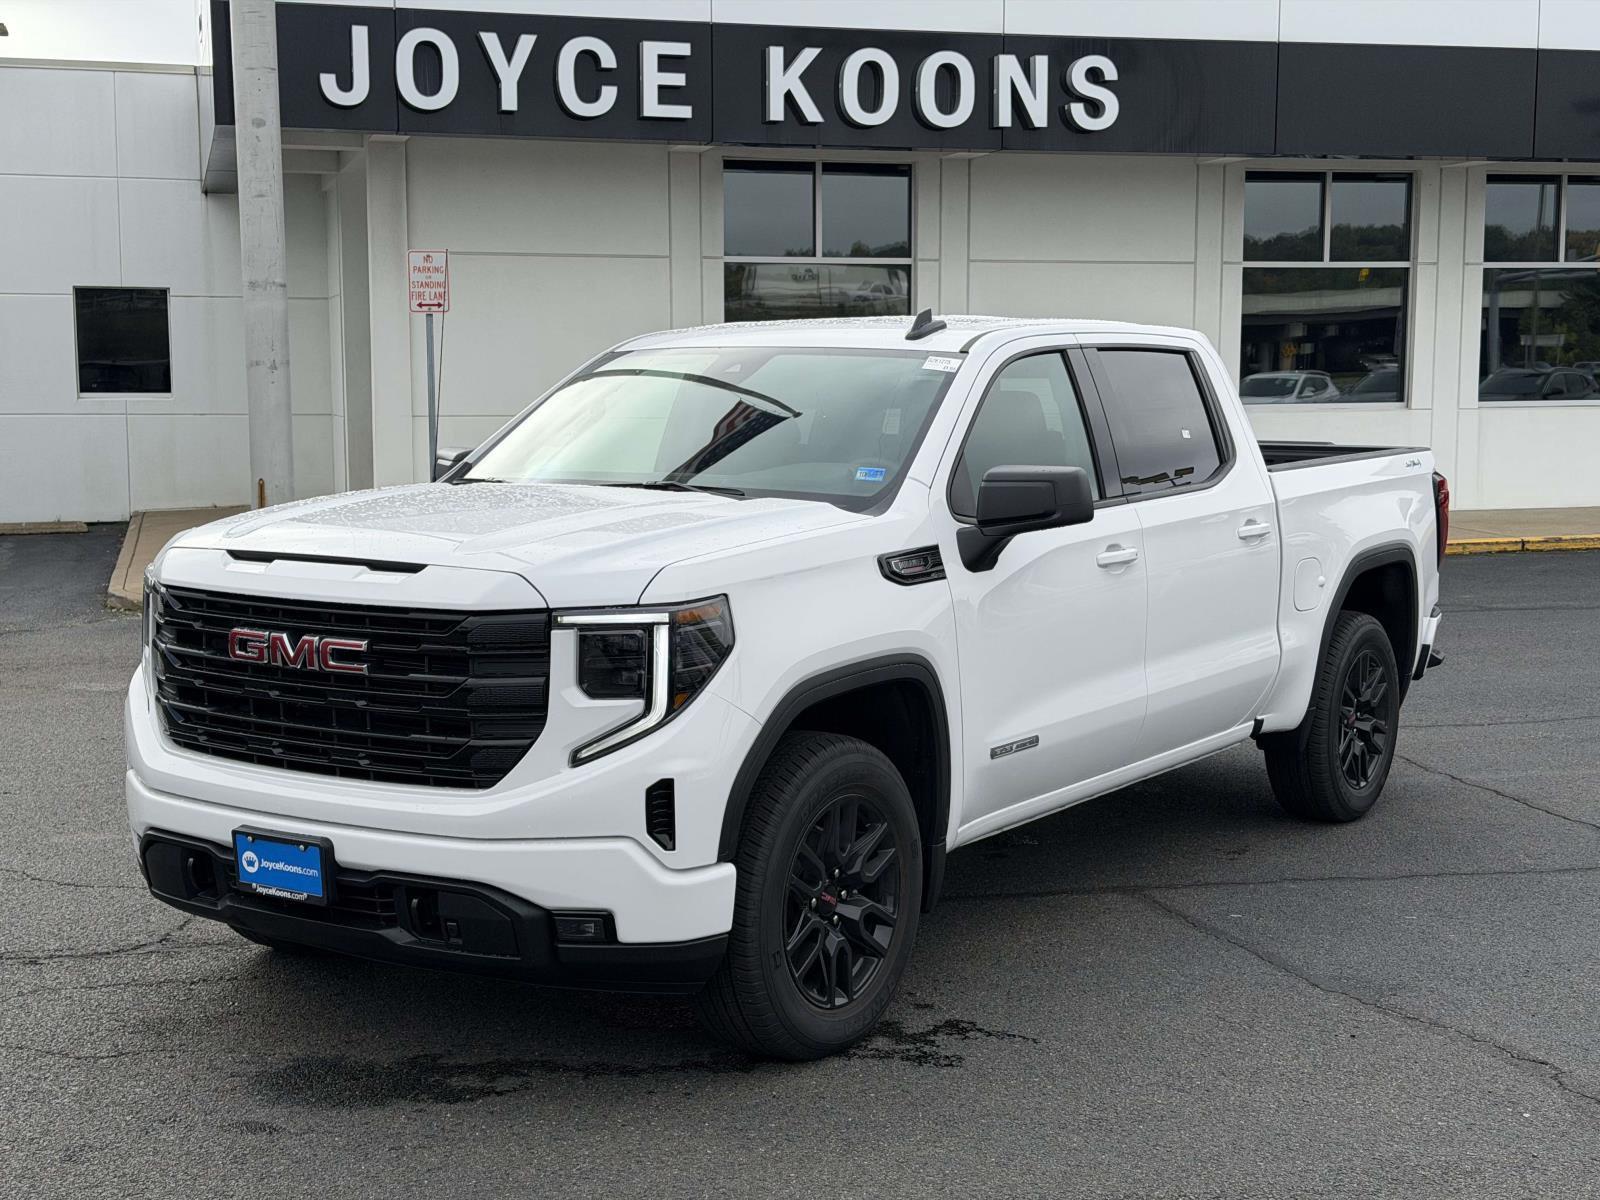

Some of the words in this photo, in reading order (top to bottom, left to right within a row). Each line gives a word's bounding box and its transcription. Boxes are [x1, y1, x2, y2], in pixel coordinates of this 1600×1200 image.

[319, 24, 693, 119] JOYCE
[764, 45, 1120, 132] KOONS
[423, 255, 434, 264] NO
[412, 265, 444, 274] PARKING
[411, 280, 446, 289] STANDING
[411, 290, 427, 301] FIRE
[228, 627, 369, 676] GMC
[260, 858, 319, 878] JoyceKoons.com
[255, 884, 306, 901] JoyceKoons.com
